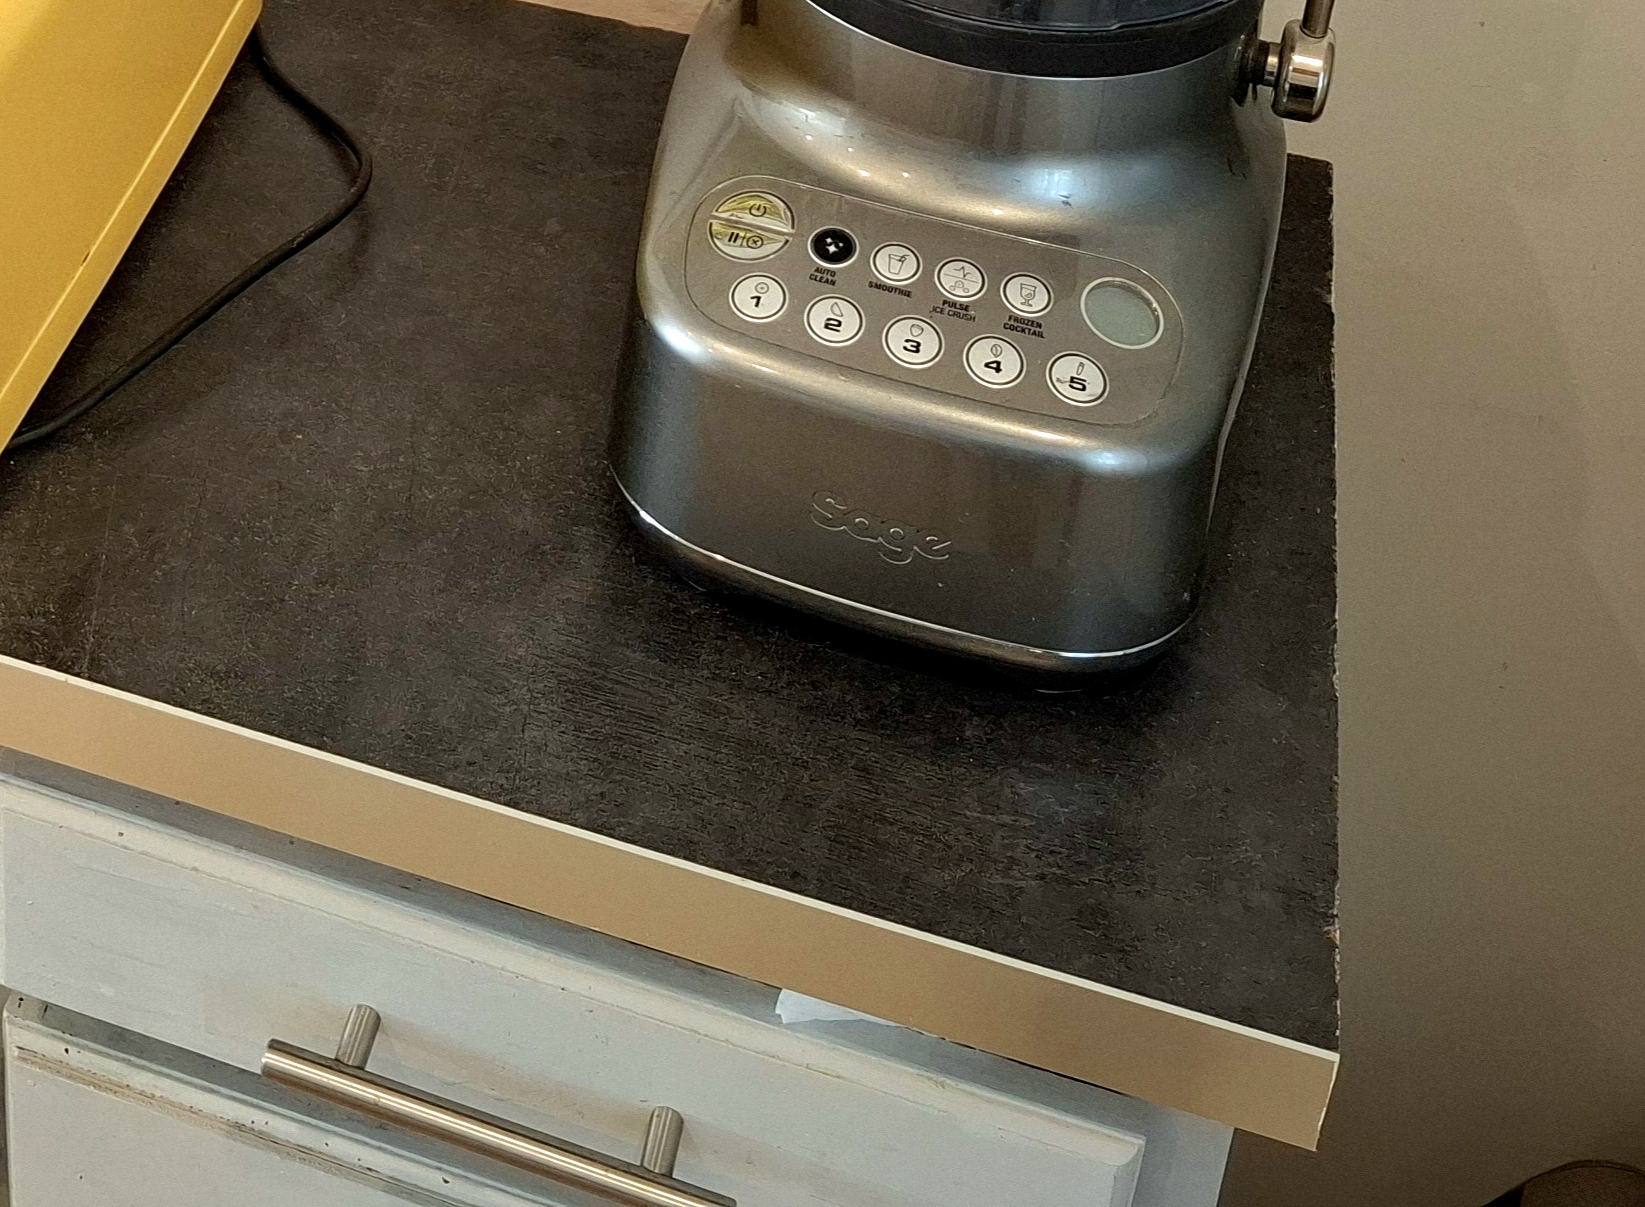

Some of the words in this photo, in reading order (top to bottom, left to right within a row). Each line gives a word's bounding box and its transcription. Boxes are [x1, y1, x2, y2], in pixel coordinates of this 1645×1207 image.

[814, 266, 837, 278] AUTO
[809, 273, 837, 287] CLEAN
[868, 280, 913, 299] SMOOTHIE
[749, 295, 762, 308] 1
[942, 299, 971, 312] PULSE
[947, 308, 977, 323] CRUSH
[1007, 314, 1043, 330] FROZEN
[823, 317, 843, 333] 2
[1002, 322, 1046, 339] COCKTAIL
[902, 338, 922, 354] 3
[983, 359, 1003, 374] 4
[1068, 375, 1088, 392] 5
